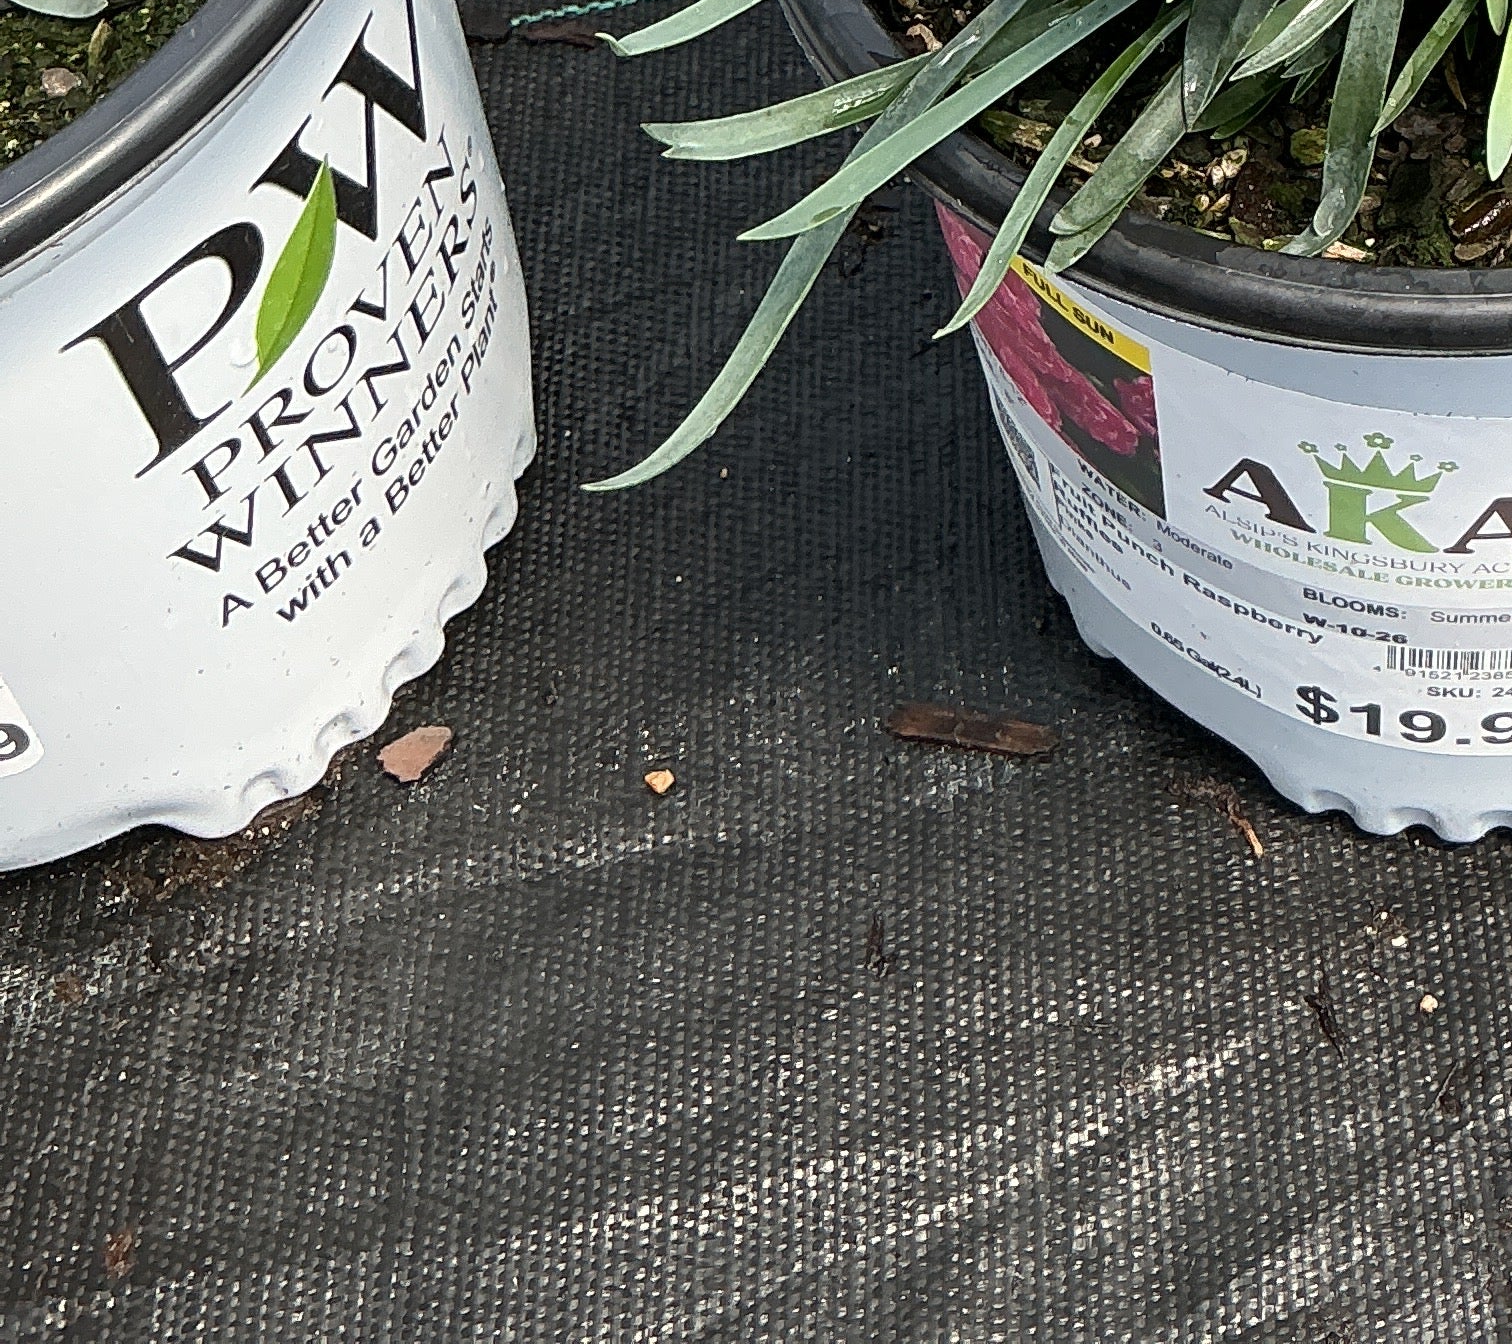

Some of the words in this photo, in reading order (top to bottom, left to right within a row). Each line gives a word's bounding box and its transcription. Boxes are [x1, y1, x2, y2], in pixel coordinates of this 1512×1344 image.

[181, 122, 456, 511] PROVEN
[1022, 263, 1069, 313] FULL
[1071, 306, 1116, 346] SUN
[221, 591, 256, 629] A
[254, 478, 364, 595] Better
[371, 334, 463, 477] Garden
[461, 219, 495, 332] Starts
[275, 549, 353, 624] with
[358, 515, 384, 549] a
[383, 392, 460, 518] Better
[1077, 458, 1147, 522] WATER:
[1155, 519, 1234, 571] Moderate
[1100, 514, 1176, 577] Punch
[1182, 572, 1324, 645] Raspberry
[1230, 528, 1390, 584] WHOLESALE
[1307, 540, 1466, 574] KINGSBURY
[1302, 587, 1408, 621] BLOOMS:
[1302, 612, 1409, 645] W-10-26
[1426, 685, 1482, 699] SKU:
